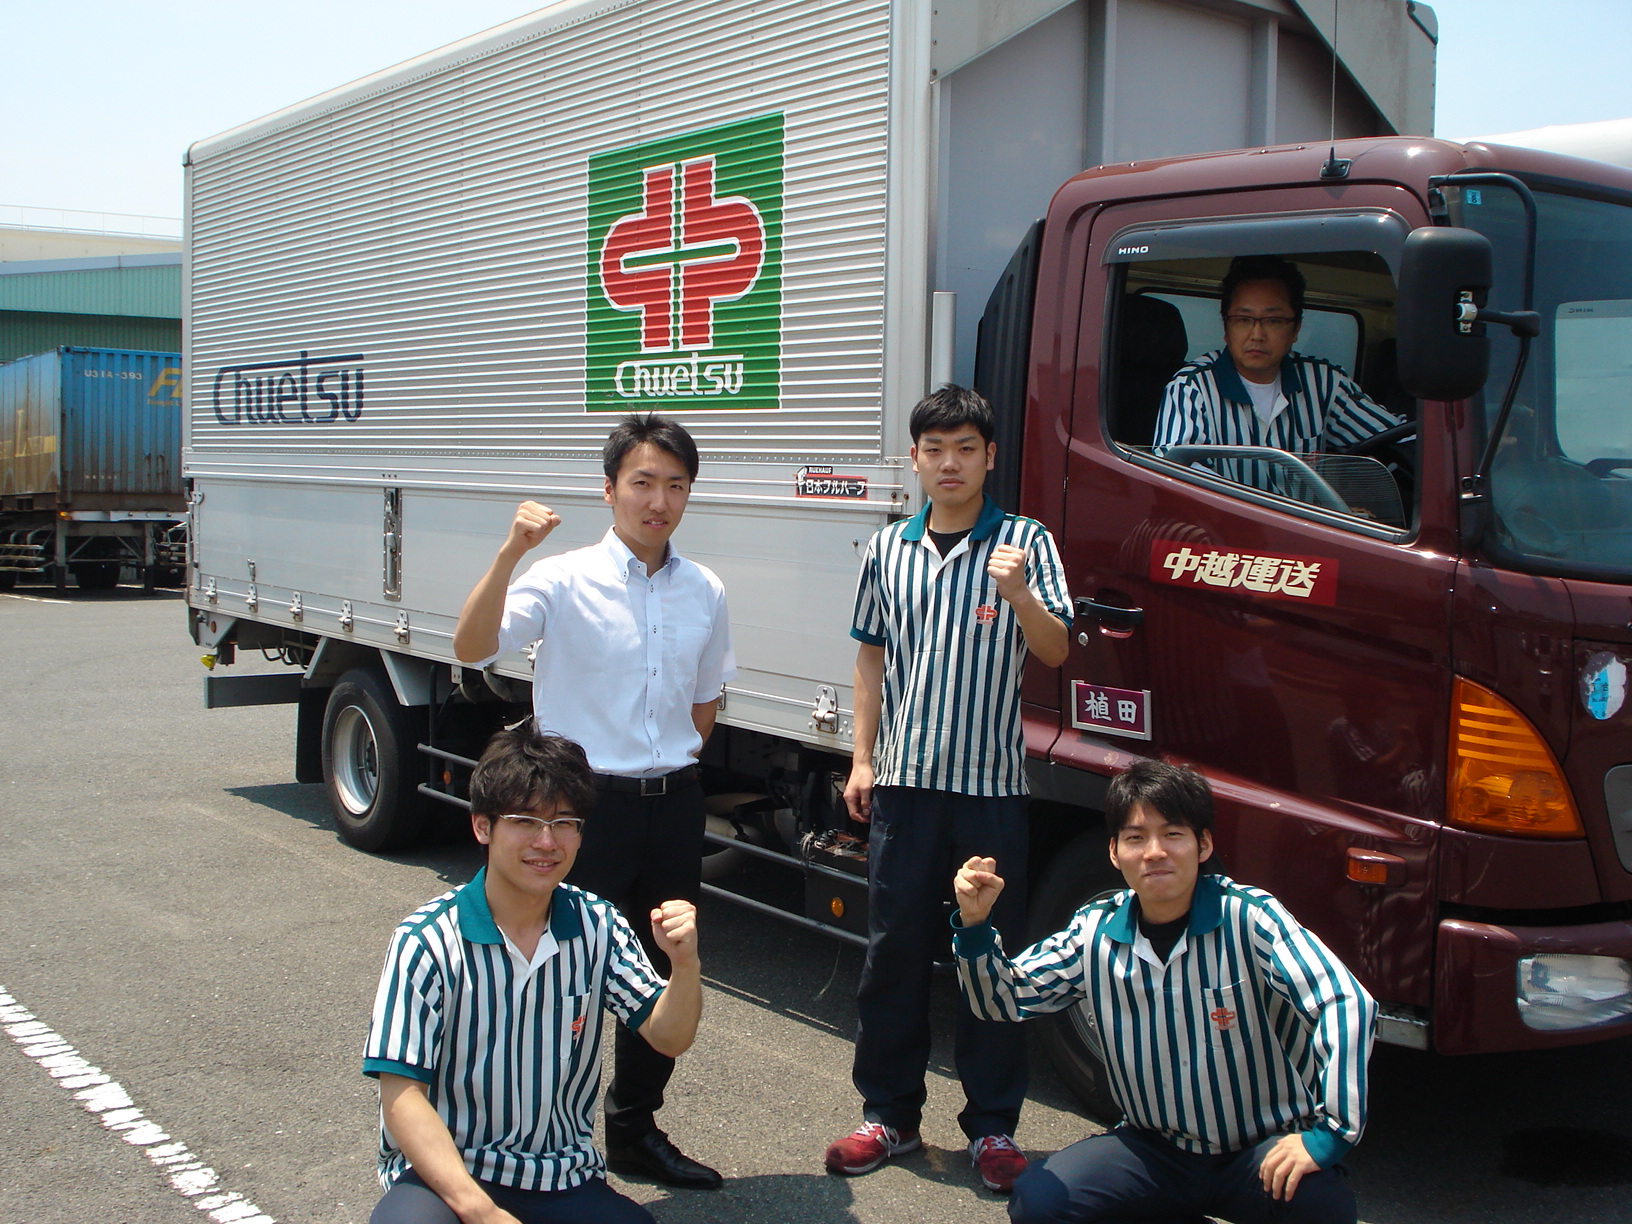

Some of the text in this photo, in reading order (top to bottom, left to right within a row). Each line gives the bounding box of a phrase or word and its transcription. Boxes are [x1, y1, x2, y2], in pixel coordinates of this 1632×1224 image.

[1118, 246, 1149, 254] HINO
[213, 351, 365, 425] Chuetsu
[615, 352, 744, 398] Chuetsu
[1162, 547, 1321, 598] 中越運送
[1084, 691, 1137, 724] 植田
